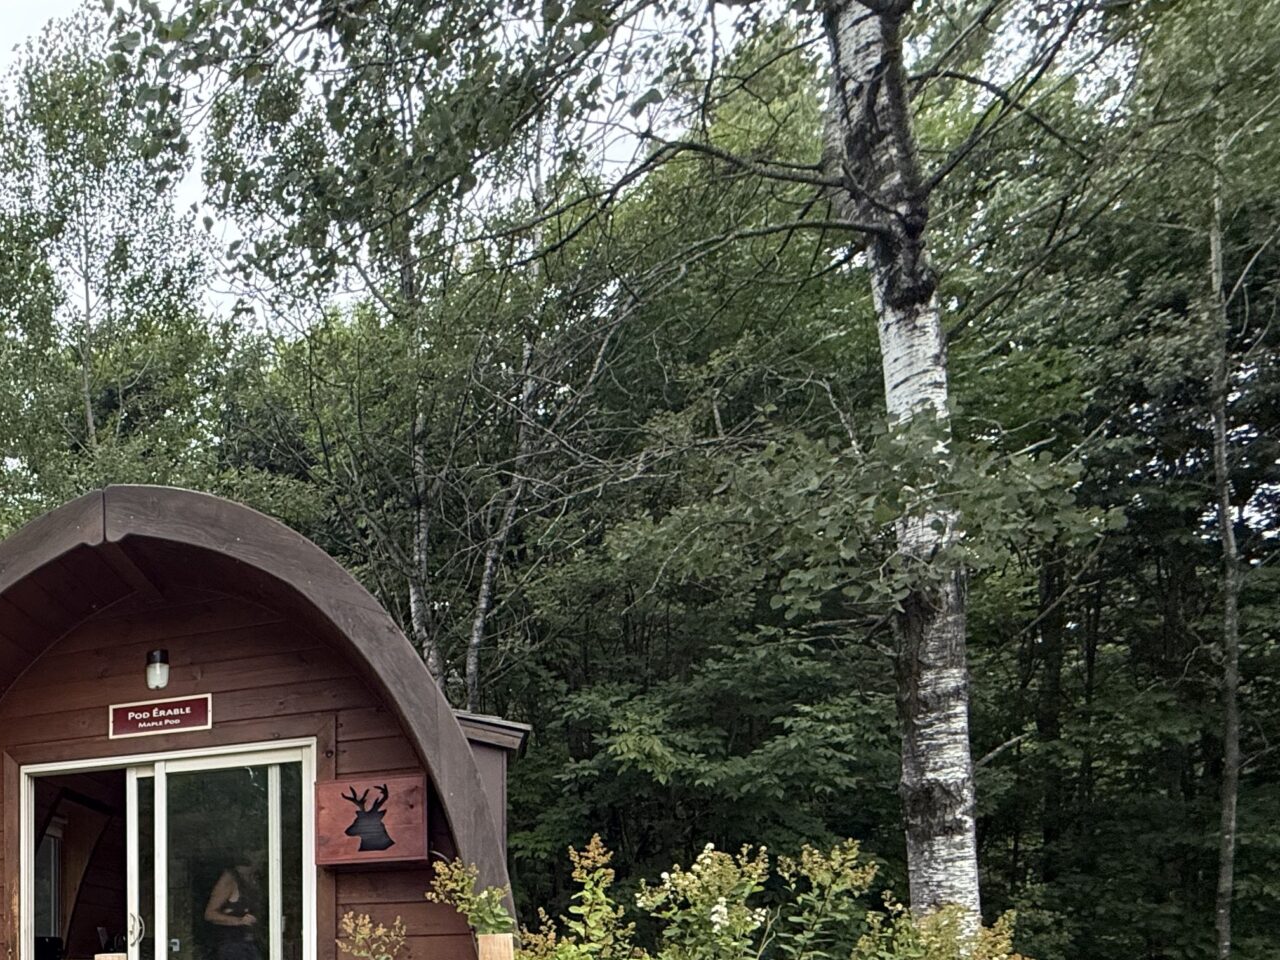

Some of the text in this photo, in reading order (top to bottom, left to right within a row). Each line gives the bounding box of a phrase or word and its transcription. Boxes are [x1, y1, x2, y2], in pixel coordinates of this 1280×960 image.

[128, 707, 191, 720] POD ÉRABLE
[138, 718, 180, 728] MAPLE POD
